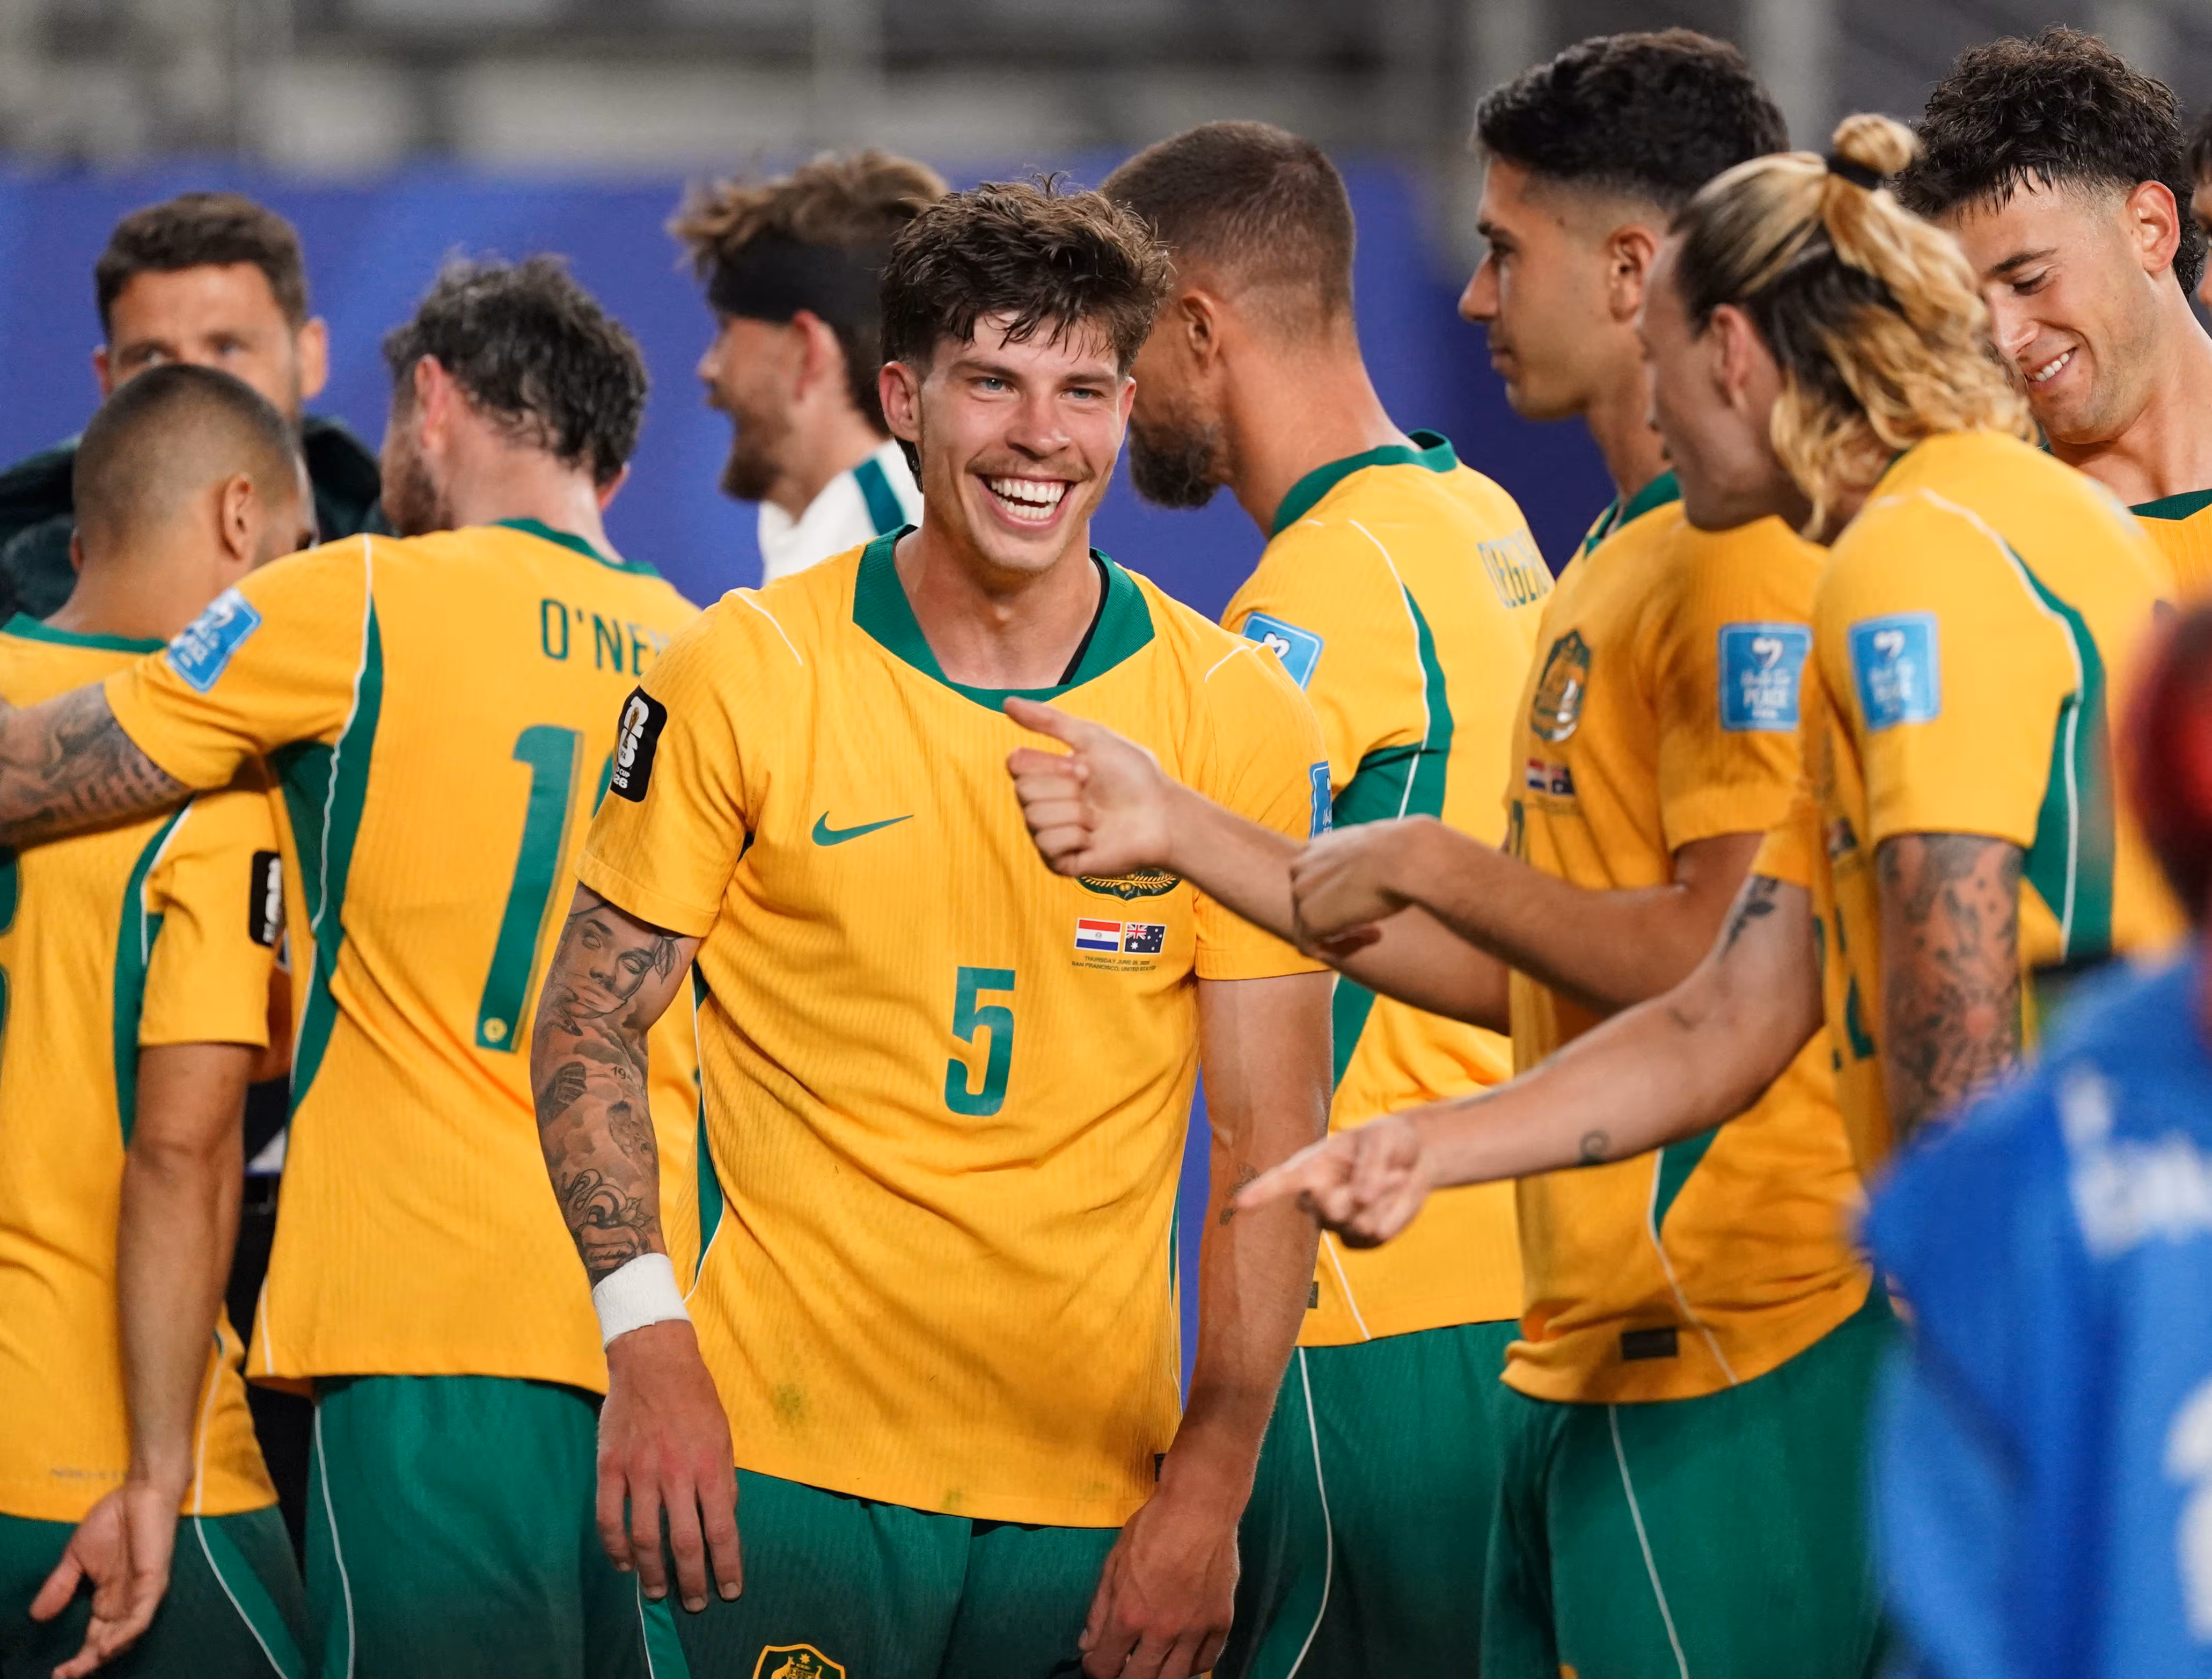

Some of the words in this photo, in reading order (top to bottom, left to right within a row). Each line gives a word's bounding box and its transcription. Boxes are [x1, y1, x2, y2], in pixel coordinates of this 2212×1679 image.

[540, 598, 670, 677] O'NE
[619, 768, 631, 778] CUP
[475, 724, 613, 1054] 1
[944, 966, 1015, 1116] 5
